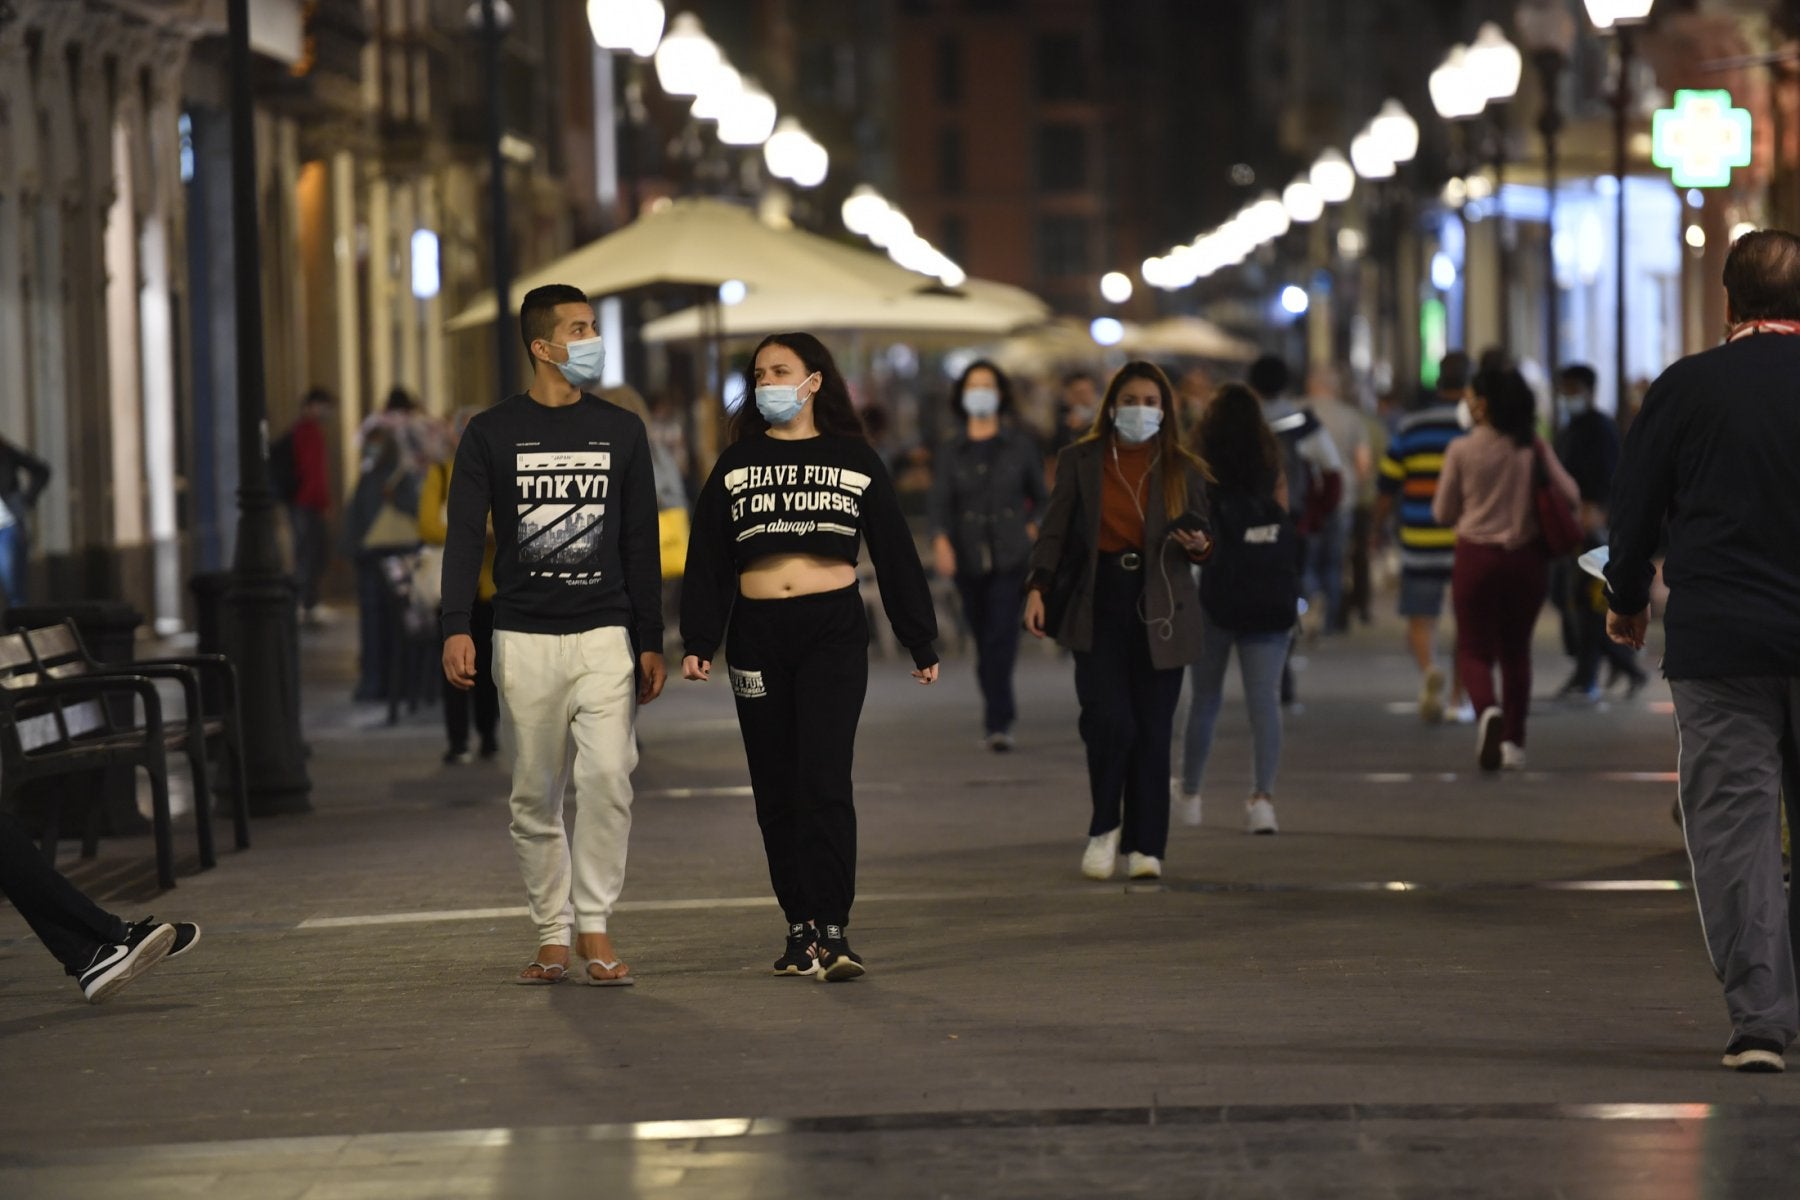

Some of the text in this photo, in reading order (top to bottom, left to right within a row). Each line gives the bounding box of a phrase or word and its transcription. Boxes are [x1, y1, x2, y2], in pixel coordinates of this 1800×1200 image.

[516, 475, 609, 499] TOKYO
[749, 465, 840, 489] HAVE FUN
[751, 493, 776, 513] ON
[766, 518, 816, 537] always
